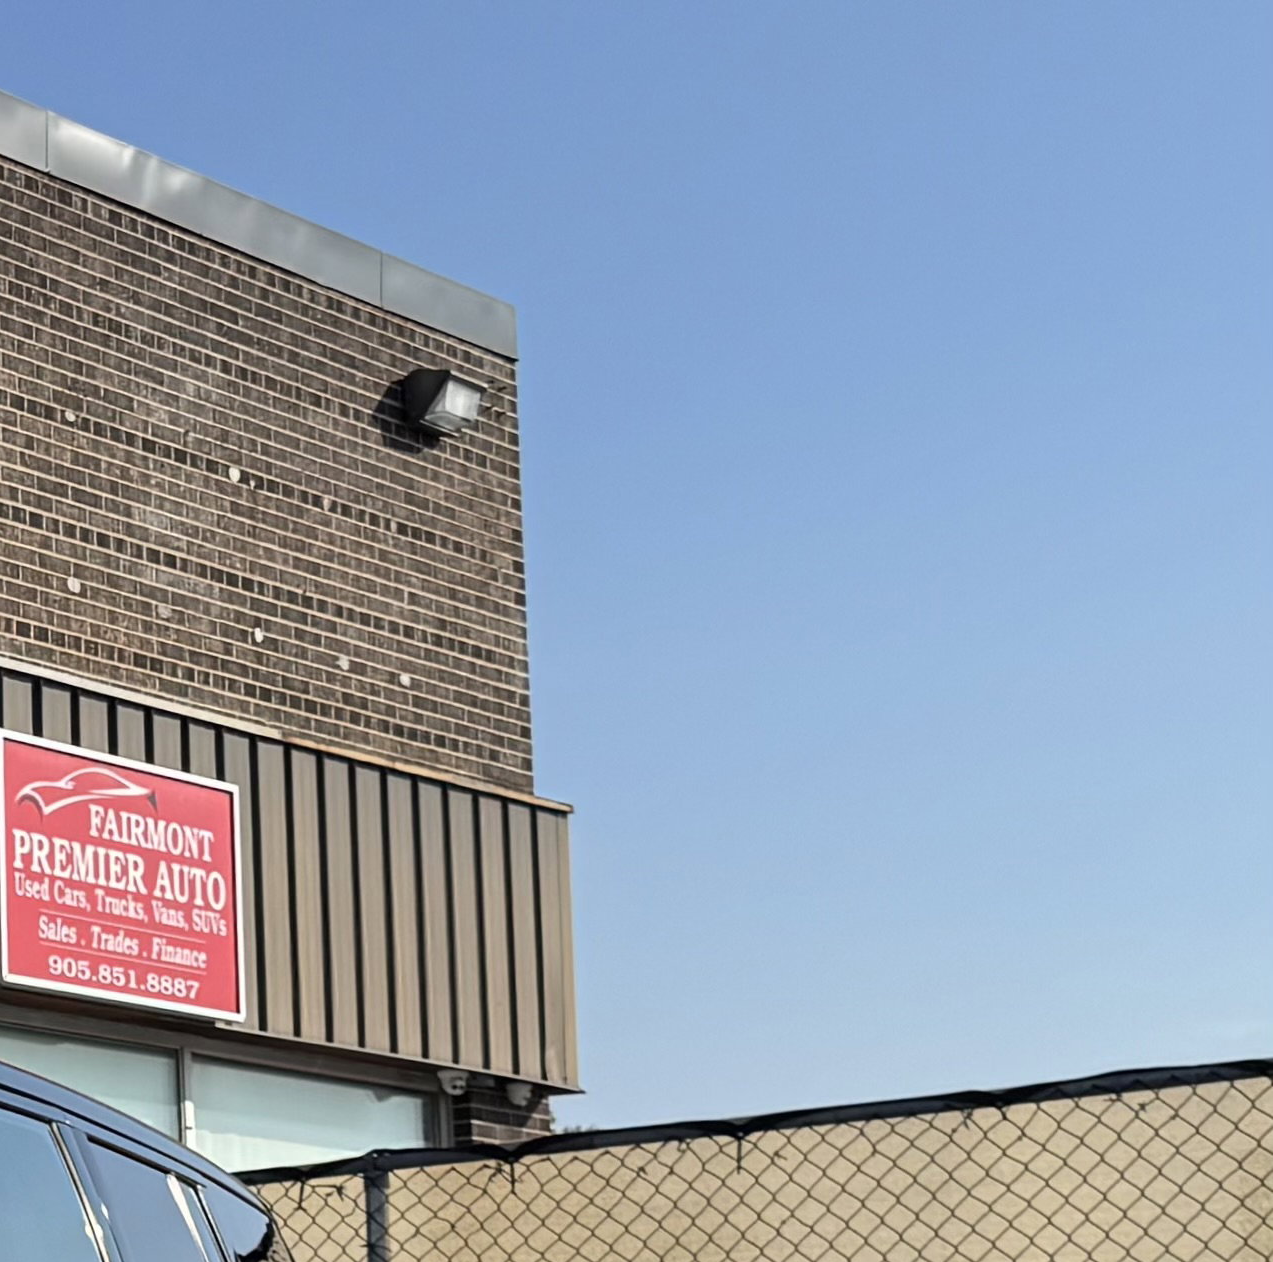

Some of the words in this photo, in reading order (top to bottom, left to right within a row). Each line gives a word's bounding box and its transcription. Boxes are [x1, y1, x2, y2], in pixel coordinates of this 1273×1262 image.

[89, 803, 215, 862] FAIRMONT
[12, 828, 148, 895] PREMIER
[154, 860, 227, 911] AUTO
[14, 872, 50, 901] Used
[54, 880, 91, 912] Cars,
[95, 889, 148, 923] Trucks,
[151, 900, 189, 931] Vans,
[192, 909, 228, 937] SUVs
[38, 915, 77, 945] Sales
[91, 925, 139, 956] Trades
[151, 938, 208, 968] Finance
[48, 954, 200, 999] 905.851.8887
